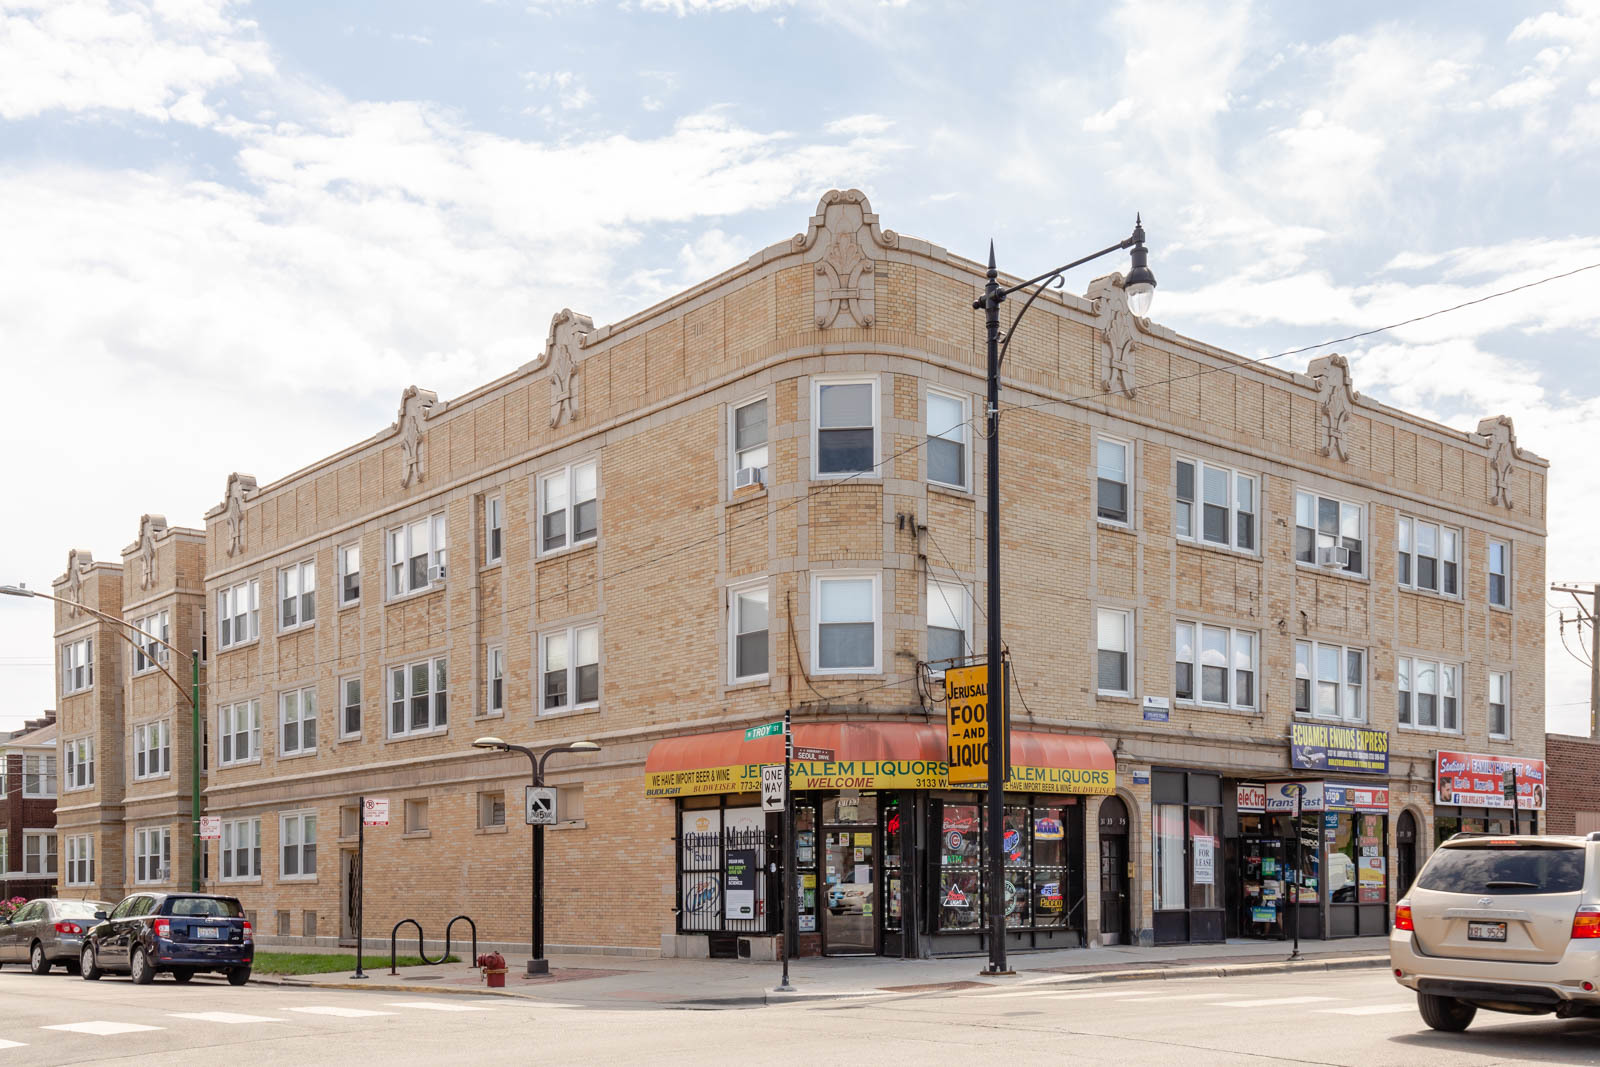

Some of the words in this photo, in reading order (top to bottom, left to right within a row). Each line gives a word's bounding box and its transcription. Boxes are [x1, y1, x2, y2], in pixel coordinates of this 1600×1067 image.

[948, 681, 988, 700] JERUSAL
[951, 704, 988, 725] FOO
[752, 725, 771, 738] TROY
[963, 727, 985, 739] AND
[1292, 724, 1328, 748] ECUAMEX
[1329, 728, 1356, 750] ENVIOS
[1356, 730, 1388, 752] EXPRESS
[798, 752, 817, 760] SEOUL
[949, 742, 988, 768] LIQUO
[862, 761, 949, 776] LIQUORS
[1472, 759, 1494, 774] FAMILY
[652, 776, 660, 786] WE
[661, 774, 674, 786] HAVE
[676, 772, 695, 784] IMPORT
[696, 770, 710, 783] BEER
[716, 769, 730, 781] WINE
[764, 770, 782, 781] ONE
[1050, 769, 1109, 784] LIQUORS
[693, 782, 736, 792] BUDWEISER
[764, 782, 782, 793] WAY
[808, 778, 874, 788] WELCOME
[916, 779, 936, 787] 3133
[1010, 782, 1022, 790] HAVE
[1023, 783, 1041, 791] IMPORT
[1042, 784, 1055, 792] BEER
[1060, 784, 1072, 792] WINE
[1325, 792, 1340, 803] vigo
[1198, 849, 1210, 857] FOR
[947, 855, 962, 863] ATM
[1195, 858, 1211, 866] LEASE
